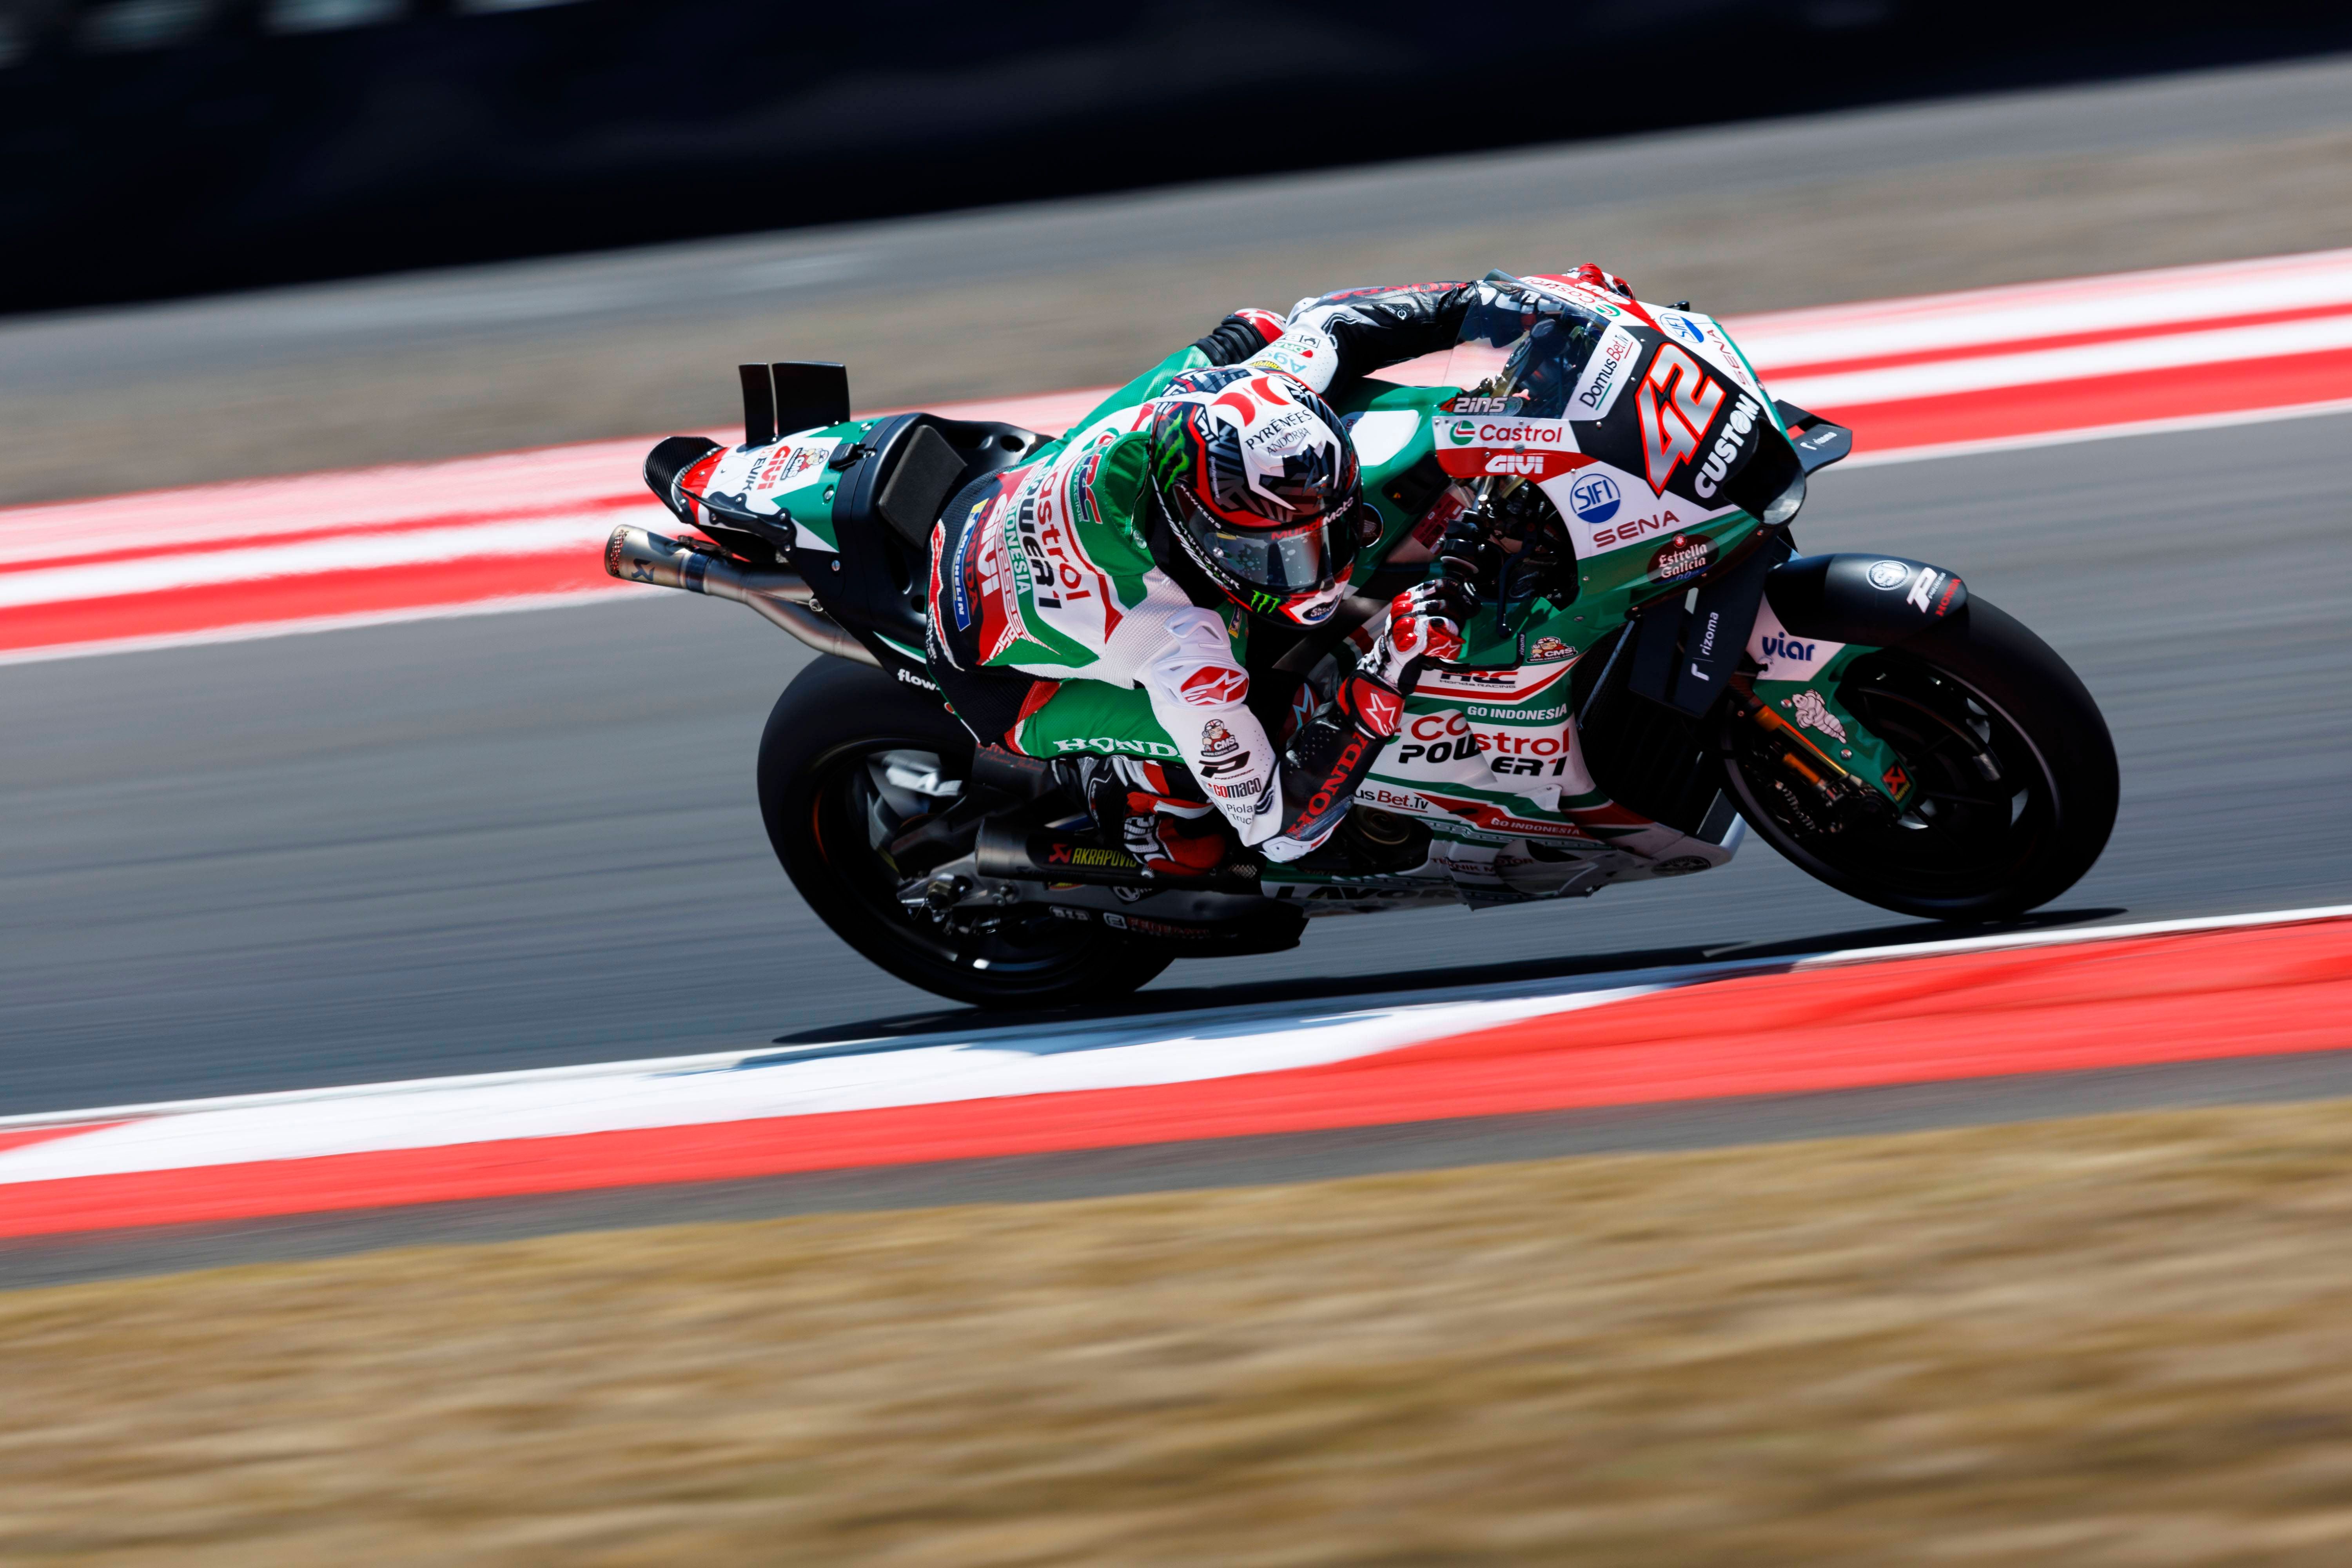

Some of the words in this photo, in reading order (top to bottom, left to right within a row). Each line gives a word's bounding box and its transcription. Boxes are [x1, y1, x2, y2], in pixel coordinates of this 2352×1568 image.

[1245, 409, 1312, 450] PYRÉNÉES
[1635, 342, 1726, 497] 42
[1267, 427, 1311, 456] ANDORRA
[1479, 424, 1562, 443] Castrol
[757, 445, 791, 490] GIVI
[1485, 455, 1544, 474] GIVI
[1181, 483, 1222, 530] HAWKERS
[1574, 479, 1613, 511] SIFI
[1593, 510, 1680, 548] SENA
[1659, 543, 1708, 568] Estrella
[1661, 557, 1706, 578] Galicia
[954, 534, 969, 615] MICHELIN
[1700, 612, 1719, 656] rizoma
[1544, 647, 1574, 657] CMS
[1467, 706, 1487, 717] GO
[1490, 703, 1568, 720] INDONESIA
[1053, 737, 1182, 757] HOND
[1214, 735, 1236, 751] CMS
[1411, 712, 1570, 756] Castrol
[1230, 813, 1253, 825] Truc
[1491, 817, 1509, 826] GO
[1511, 820, 1581, 835] INDONESIA
